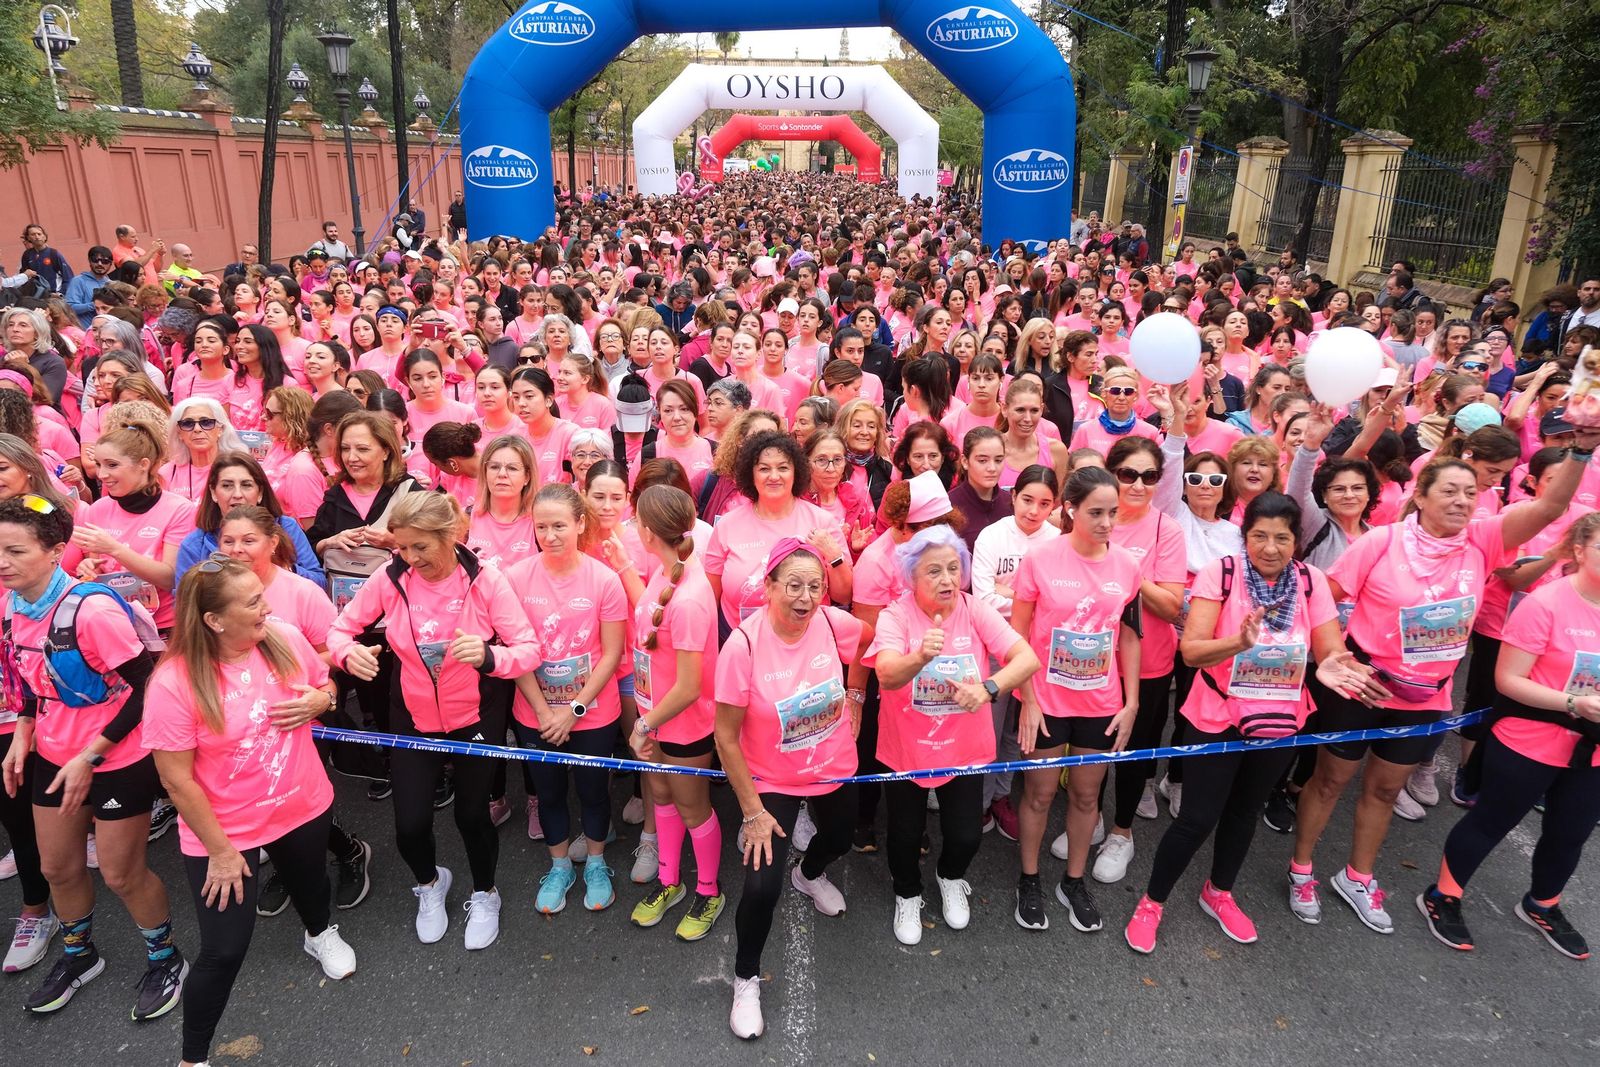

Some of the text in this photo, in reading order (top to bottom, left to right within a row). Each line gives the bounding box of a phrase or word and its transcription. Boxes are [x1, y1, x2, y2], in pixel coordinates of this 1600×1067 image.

[514, 19, 588, 35] ASTURIANA
[934, 25, 1013, 42] ASTURIANA
[727, 73, 845, 100] OYSHO
[758, 122, 824, 131] Sports Santander
[468, 161, 534, 179] ASTURIANA
[640, 166, 669, 176] OYSHO
[904, 168, 934, 177] OYSHO
[998, 164, 1066, 182] ASTURIANA
[996, 558, 1014, 576] LOS
[1052, 579, 1080, 588] OYSHO
[1428, 628, 1456, 640] 016
[1072, 658, 1096, 668] 016
[764, 670, 793, 681] OYSHO
[1255, 667, 1280, 676] 016
[548, 684, 574, 694] 016
[802, 712, 826, 726] 016
[412, 742, 450, 753] ASTURIANA
[487, 750, 526, 760] ASTURIANA
[562, 758, 602, 768] ASTURIANA
